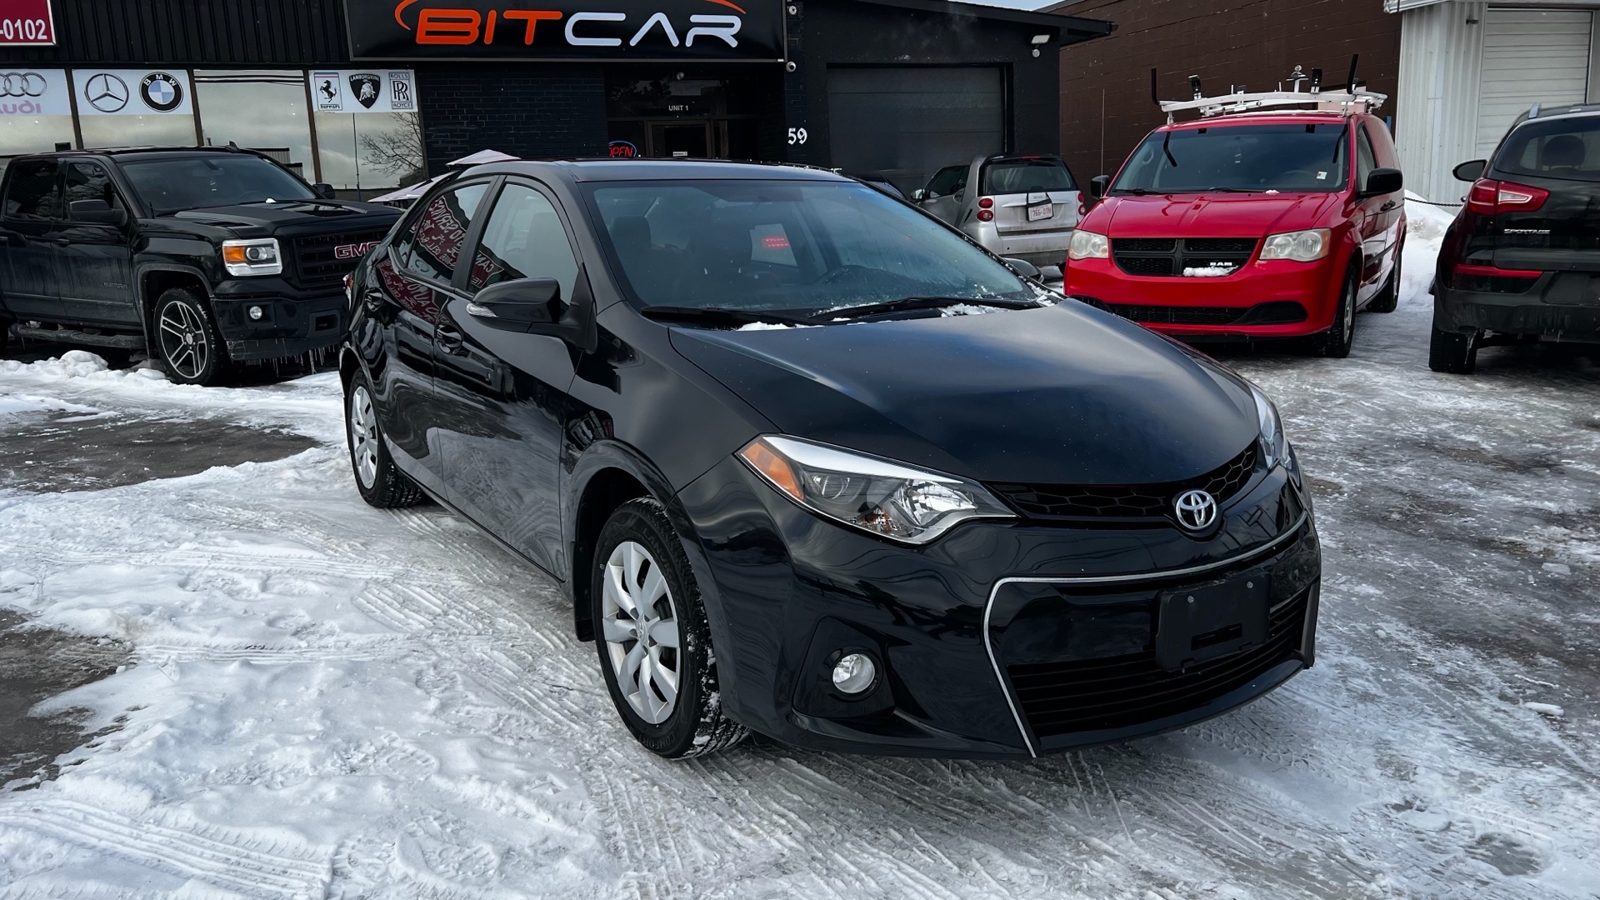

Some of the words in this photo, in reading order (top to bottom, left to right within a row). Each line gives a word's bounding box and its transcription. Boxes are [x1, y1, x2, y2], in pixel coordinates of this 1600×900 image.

[0, 19, 47, 39] -0102
[416, 9, 743, 48] BITCAR
[144, 74, 177, 86] BMW
[0, 100, 42, 114] udi
[788, 127, 807, 144] 59
